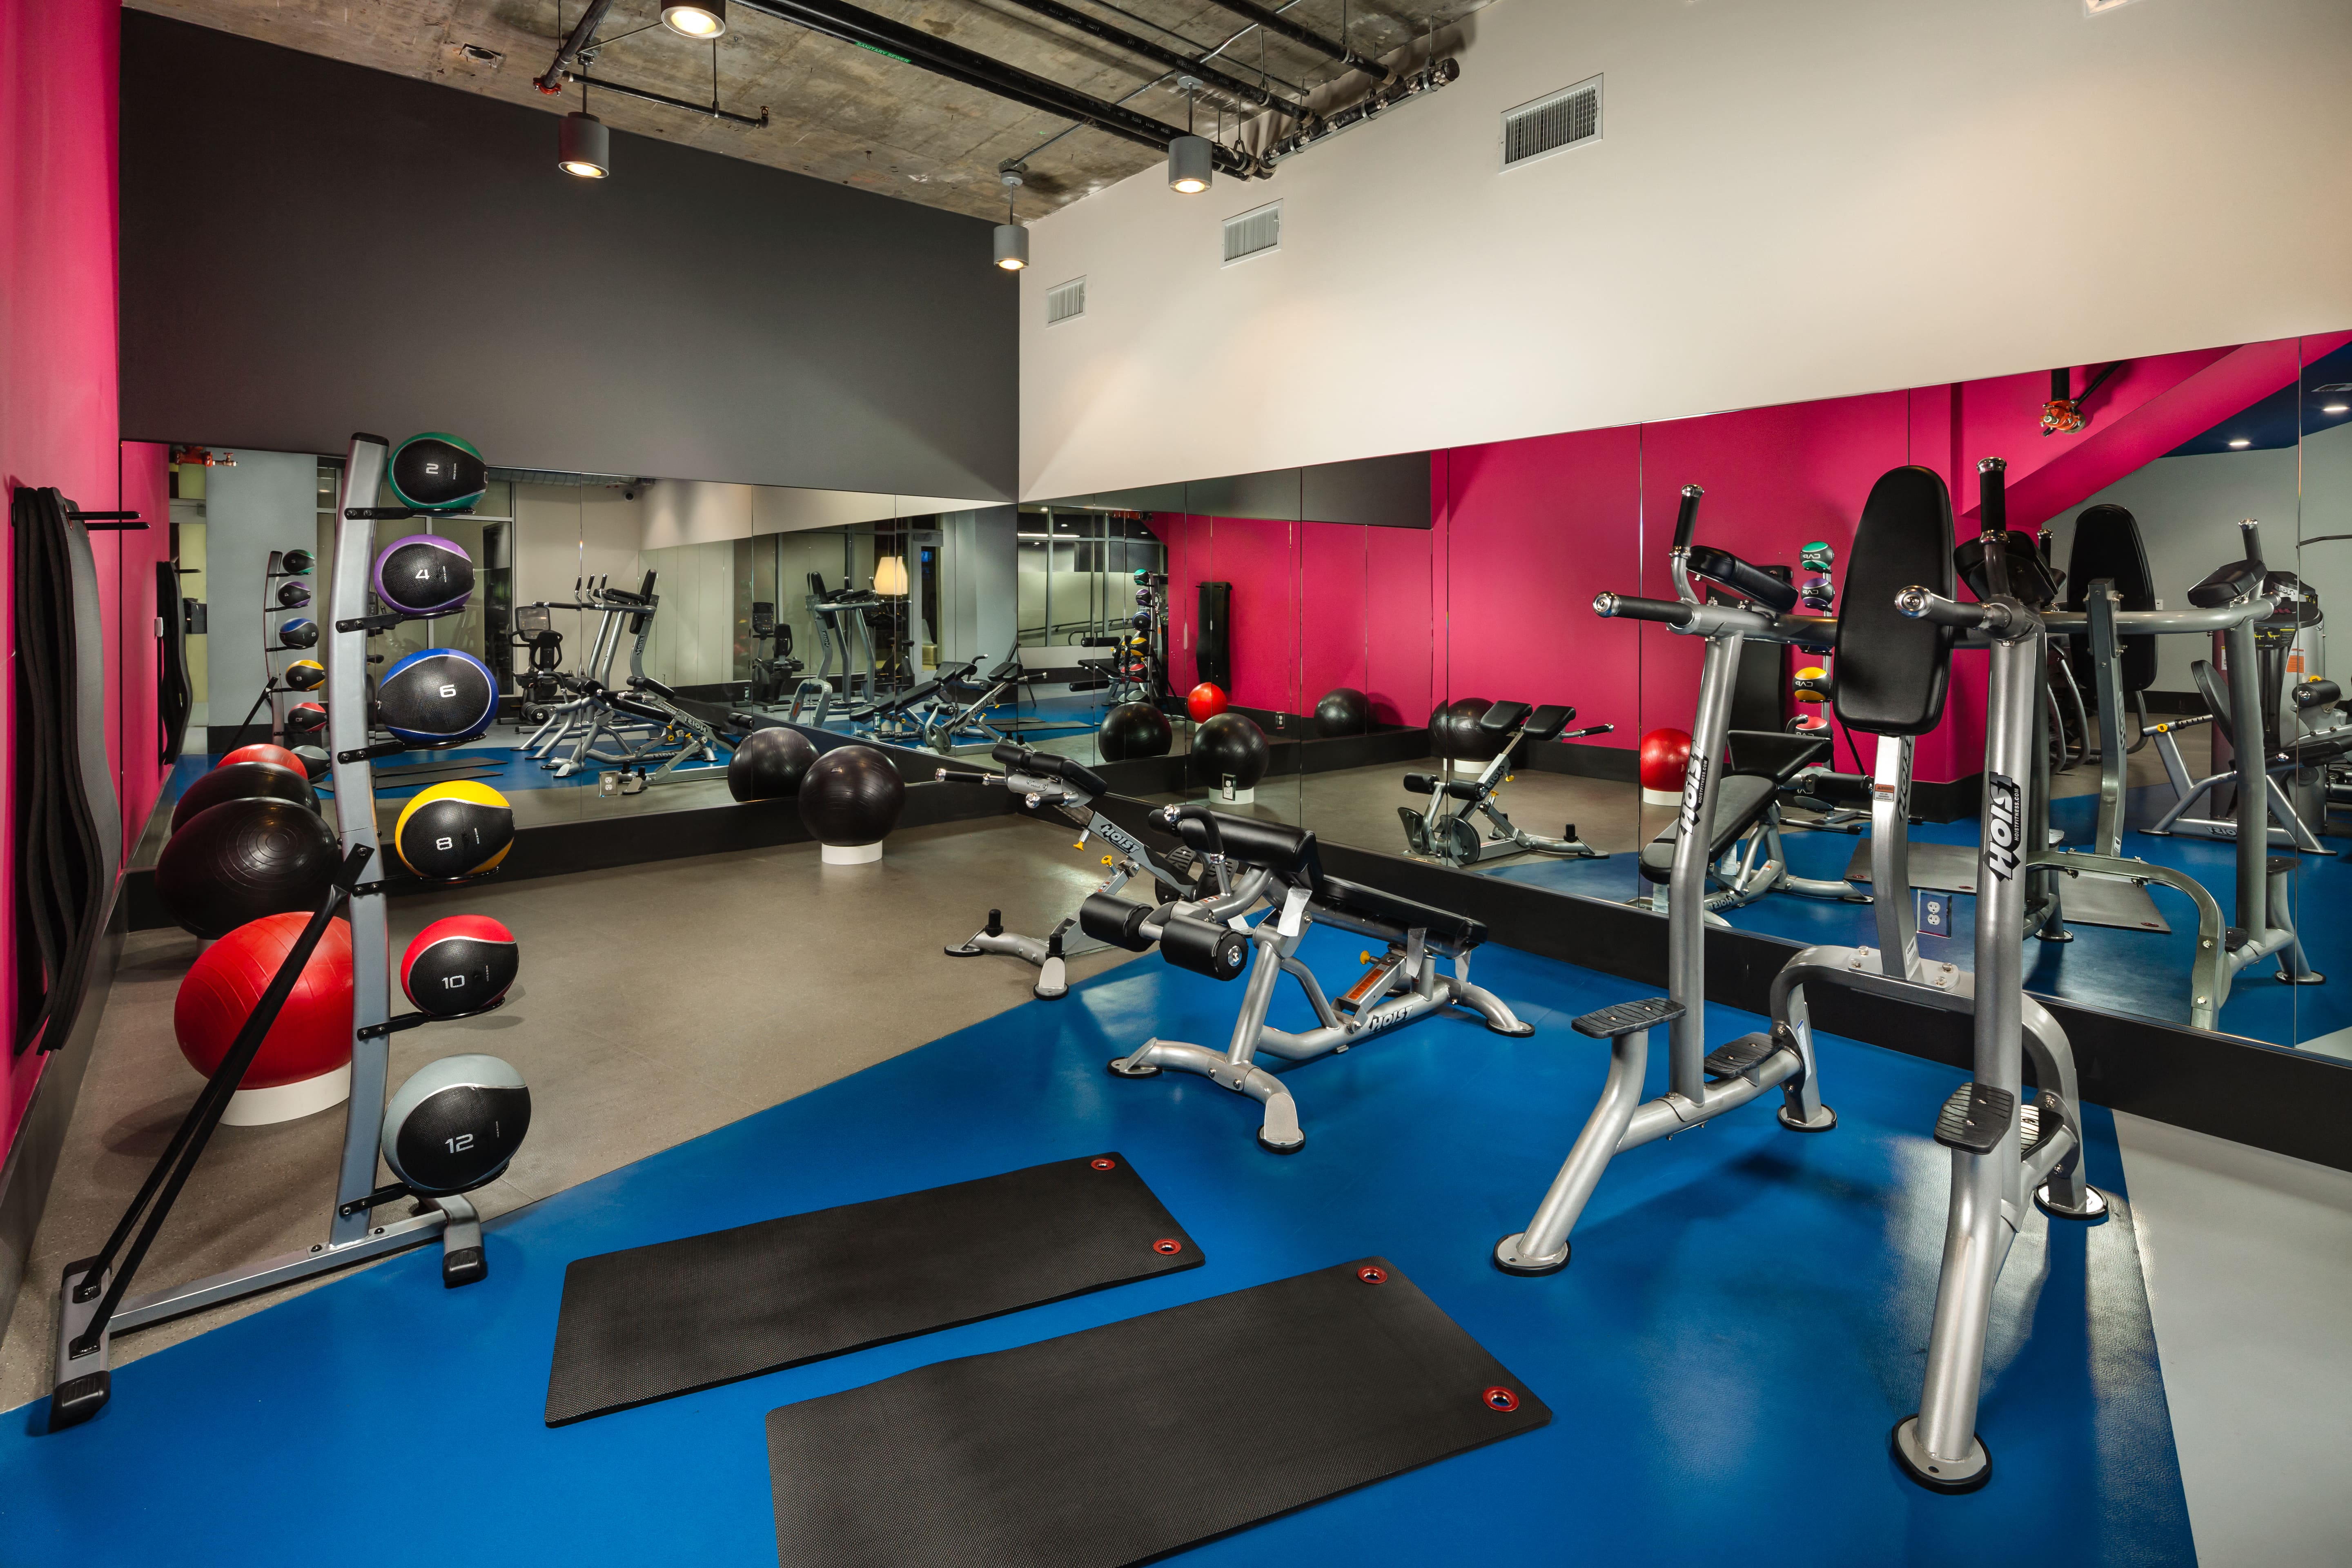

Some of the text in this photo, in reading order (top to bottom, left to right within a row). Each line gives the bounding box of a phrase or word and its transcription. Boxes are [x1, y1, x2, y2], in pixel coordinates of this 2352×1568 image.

[857, 42, 909, 63] SANITARY SEWER
[426, 463, 439, 474] 2
[415, 569, 430, 579] 4
[440, 684, 456, 697] 6
[1680, 740, 1704, 834] HOIST
[1694, 760, 1707, 803] HOISTFITNESS.COM
[1989, 772, 2012, 880] HOIST
[436, 837, 452, 850] 8
[1100, 825, 1140, 853] HOIST
[442, 975, 465, 989] 10
[1371, 1005, 1413, 1031] HOIST
[445, 1134, 474, 1153] 12
